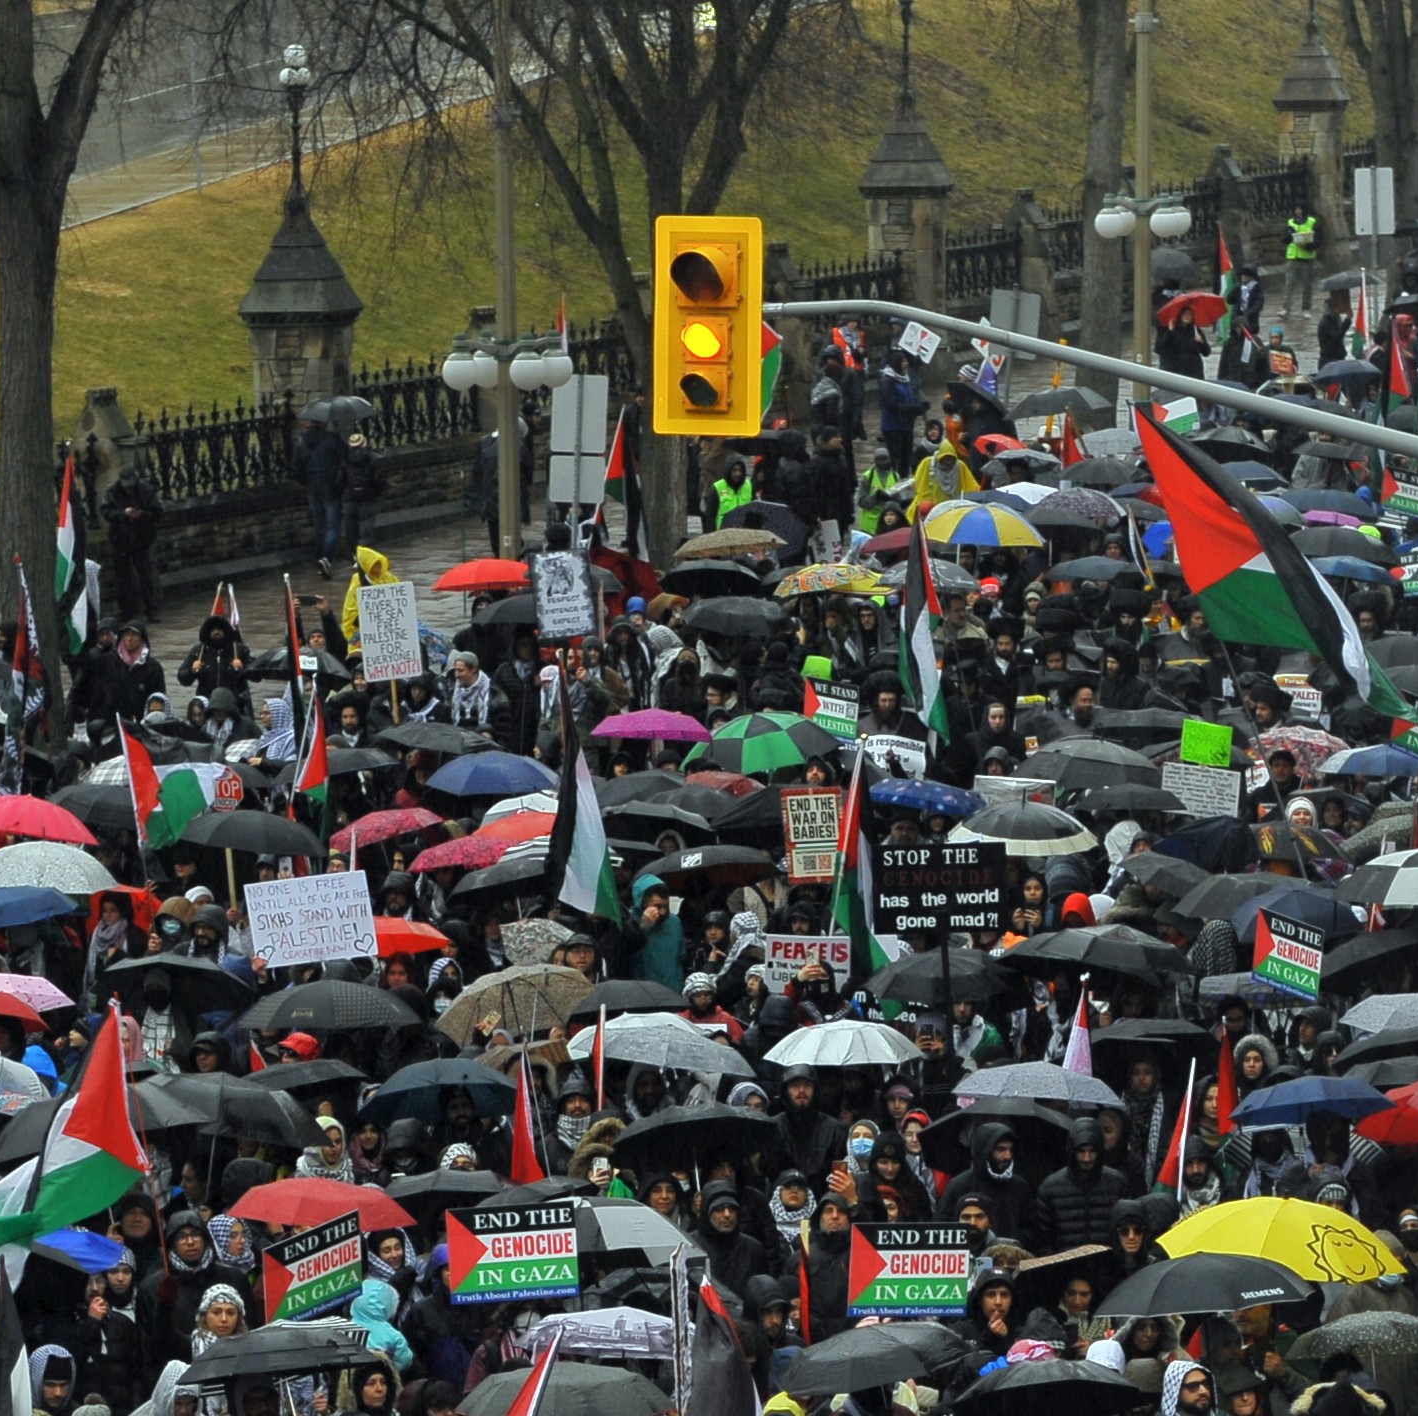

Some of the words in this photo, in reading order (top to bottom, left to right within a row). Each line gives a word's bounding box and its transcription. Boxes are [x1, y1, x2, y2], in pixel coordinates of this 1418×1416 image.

[361, 588, 386, 601] FROM
[390, 585, 406, 597] THE
[386, 608, 405, 620] SEA
[376, 619, 400, 632] FREE
[363, 630, 409, 645] PALESTINE
[380, 642, 402, 655] FOR
[813, 681, 828, 693] WE
[830, 684, 858, 700] STAND
[821, 701, 844, 715] WITH
[875, 738, 924, 753] responsible
[789, 797, 812, 811] END
[814, 796, 834, 810] THE
[791, 811, 816, 825] WAR
[820, 810, 835, 824] ON
[792, 824, 837, 841] BABIES!
[883, 849, 930, 866] STOP
[942, 848, 979, 864] THE
[883, 869, 994, 887] GENOCIDE
[880, 893, 910, 908] has
[920, 892, 947, 906] the
[955, 888, 999, 904] world
[257, 913, 294, 931] SIKHS
[297, 908, 335, 925] STAND
[337, 903, 368, 920] WITH
[267, 922, 360, 949] PALESTINE!
[1271, 917, 1294, 937] END
[1297, 926, 1322, 947] THE
[1277, 939, 1319, 971] GENOCIDE
[1266, 960, 1281, 975] IN
[1283, 966, 1316, 990] GAZA
[473, 1210, 520, 1230] END
[526, 1207, 573, 1227] THE
[283, 1236, 319, 1261] END
[322, 1217, 358, 1243] THE
[490, 1232, 574, 1258] GENOCIDE
[876, 1229, 920, 1245] END
[927, 1229, 968, 1245] THE
[297, 1241, 359, 1281] GENOCIDE
[890, 1253, 966, 1275] GENOCIDE
[477, 1268, 503, 1286] IN
[510, 1263, 574, 1283] GAZA
[286, 1293, 308, 1311] IN
[311, 1269, 359, 1300] GAZA
[455, 1293, 481, 1303] Truth
[482, 1291, 510, 1300] About
[511, 1287, 577, 1299] Palestine.com
[873, 1285, 898, 1301] IN
[905, 1284, 963, 1301] GAZA
[1241, 1287, 1285, 1299] SIEMENS
